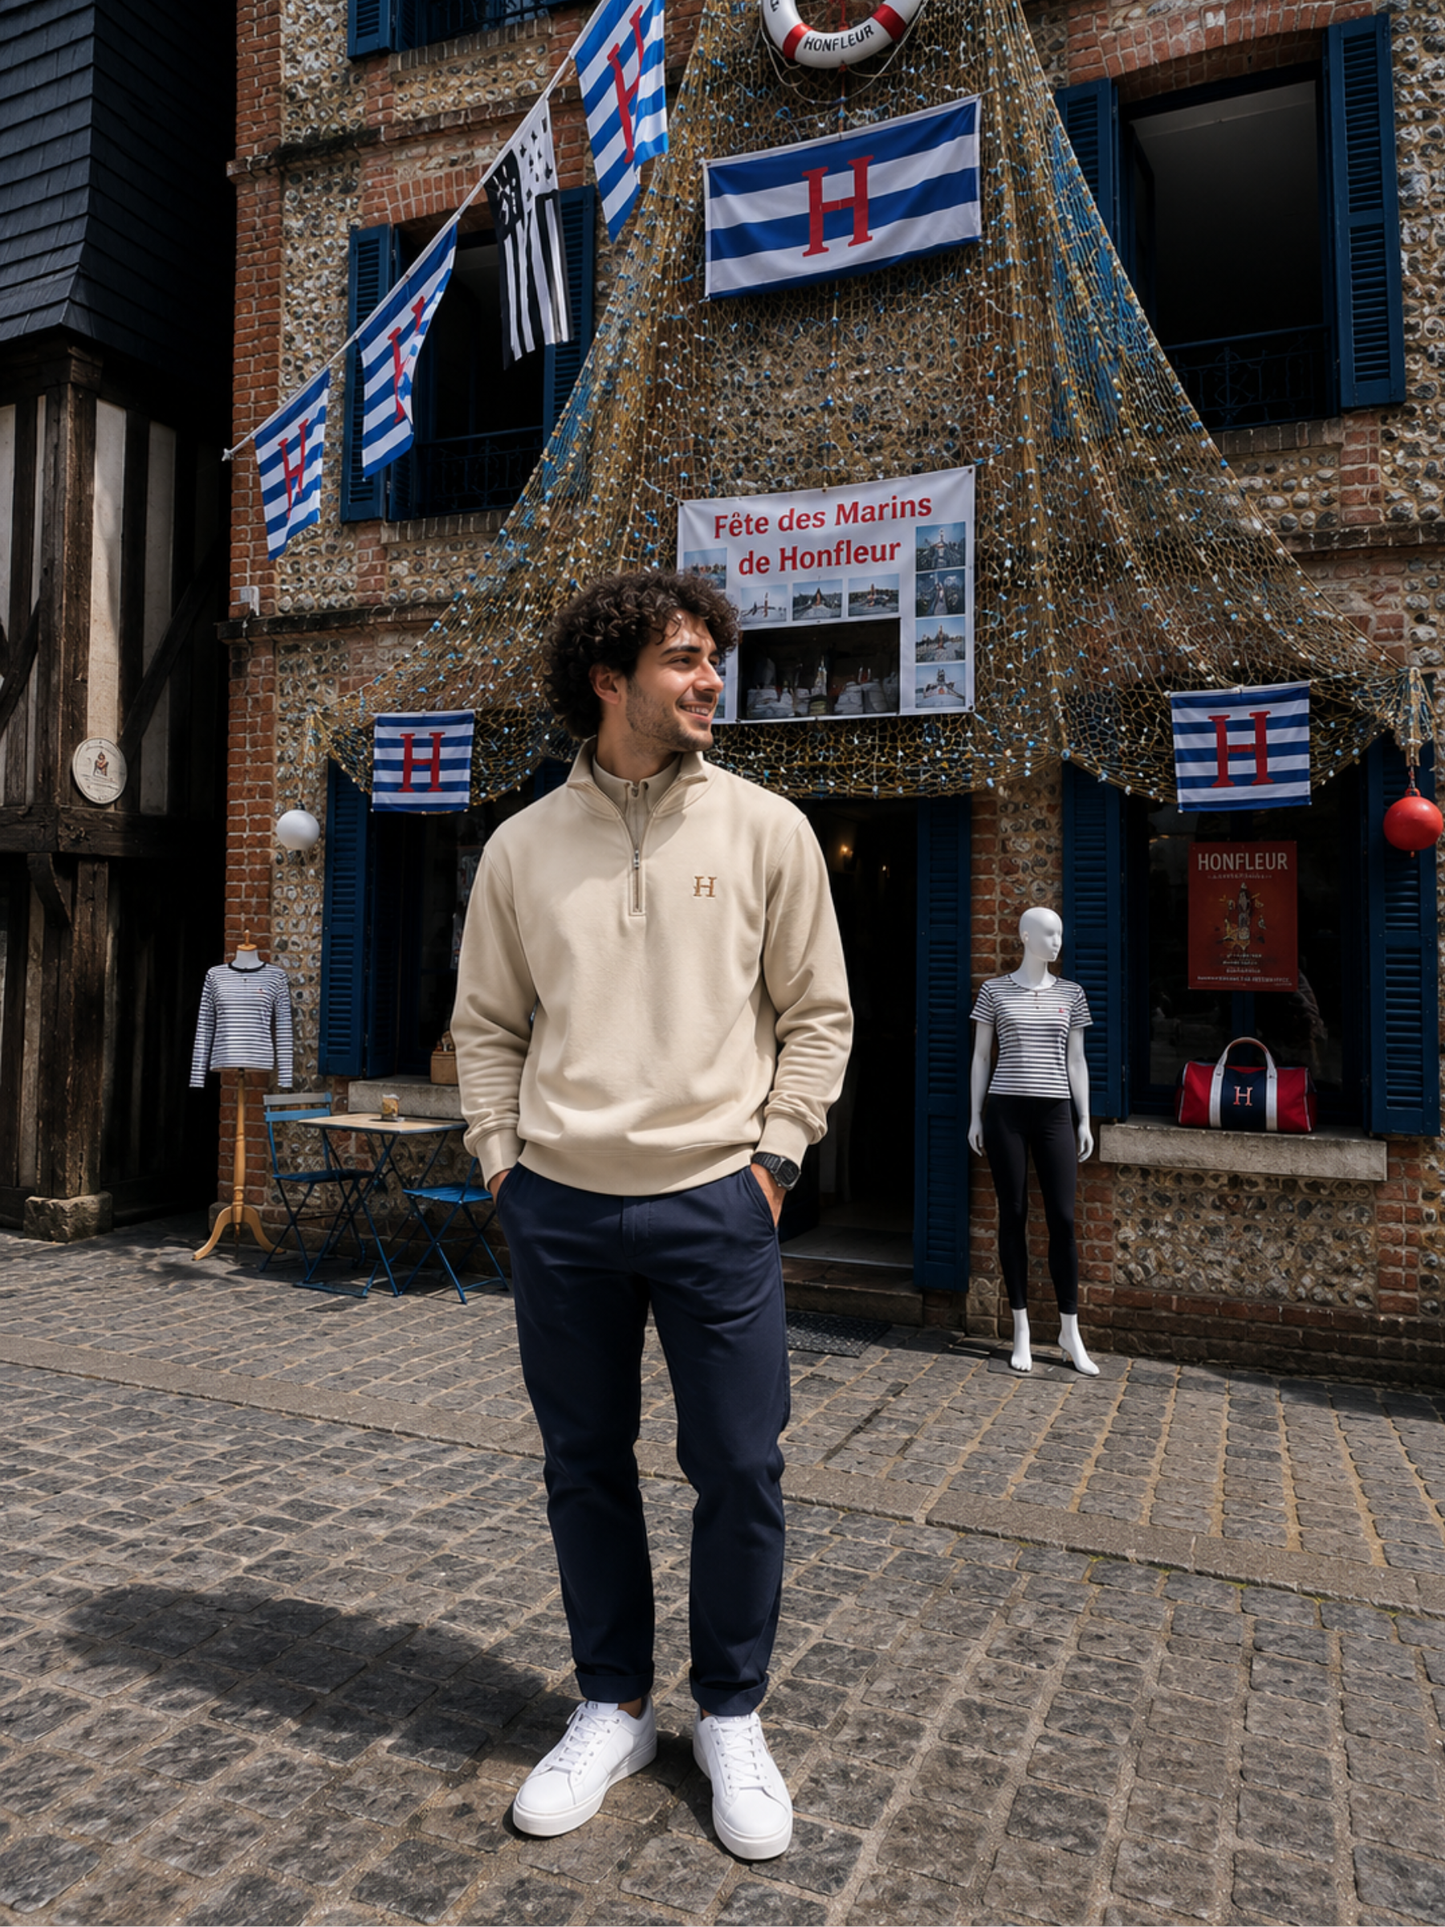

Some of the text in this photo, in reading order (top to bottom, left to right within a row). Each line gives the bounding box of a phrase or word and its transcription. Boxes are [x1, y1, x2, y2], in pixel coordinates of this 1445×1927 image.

[803, 24, 875, 52] HONFLEUR
[802, 154, 874, 257] H
[714, 495, 933, 539] Fête des Marins
[738, 540, 901, 576] de Honfleur
[398, 731, 446, 793] H
[1207, 710, 1275, 788] H
[1197, 852, 1289, 871] HONFLEUR
[692, 876, 718, 898] H
[1233, 1085, 1254, 1107] H
